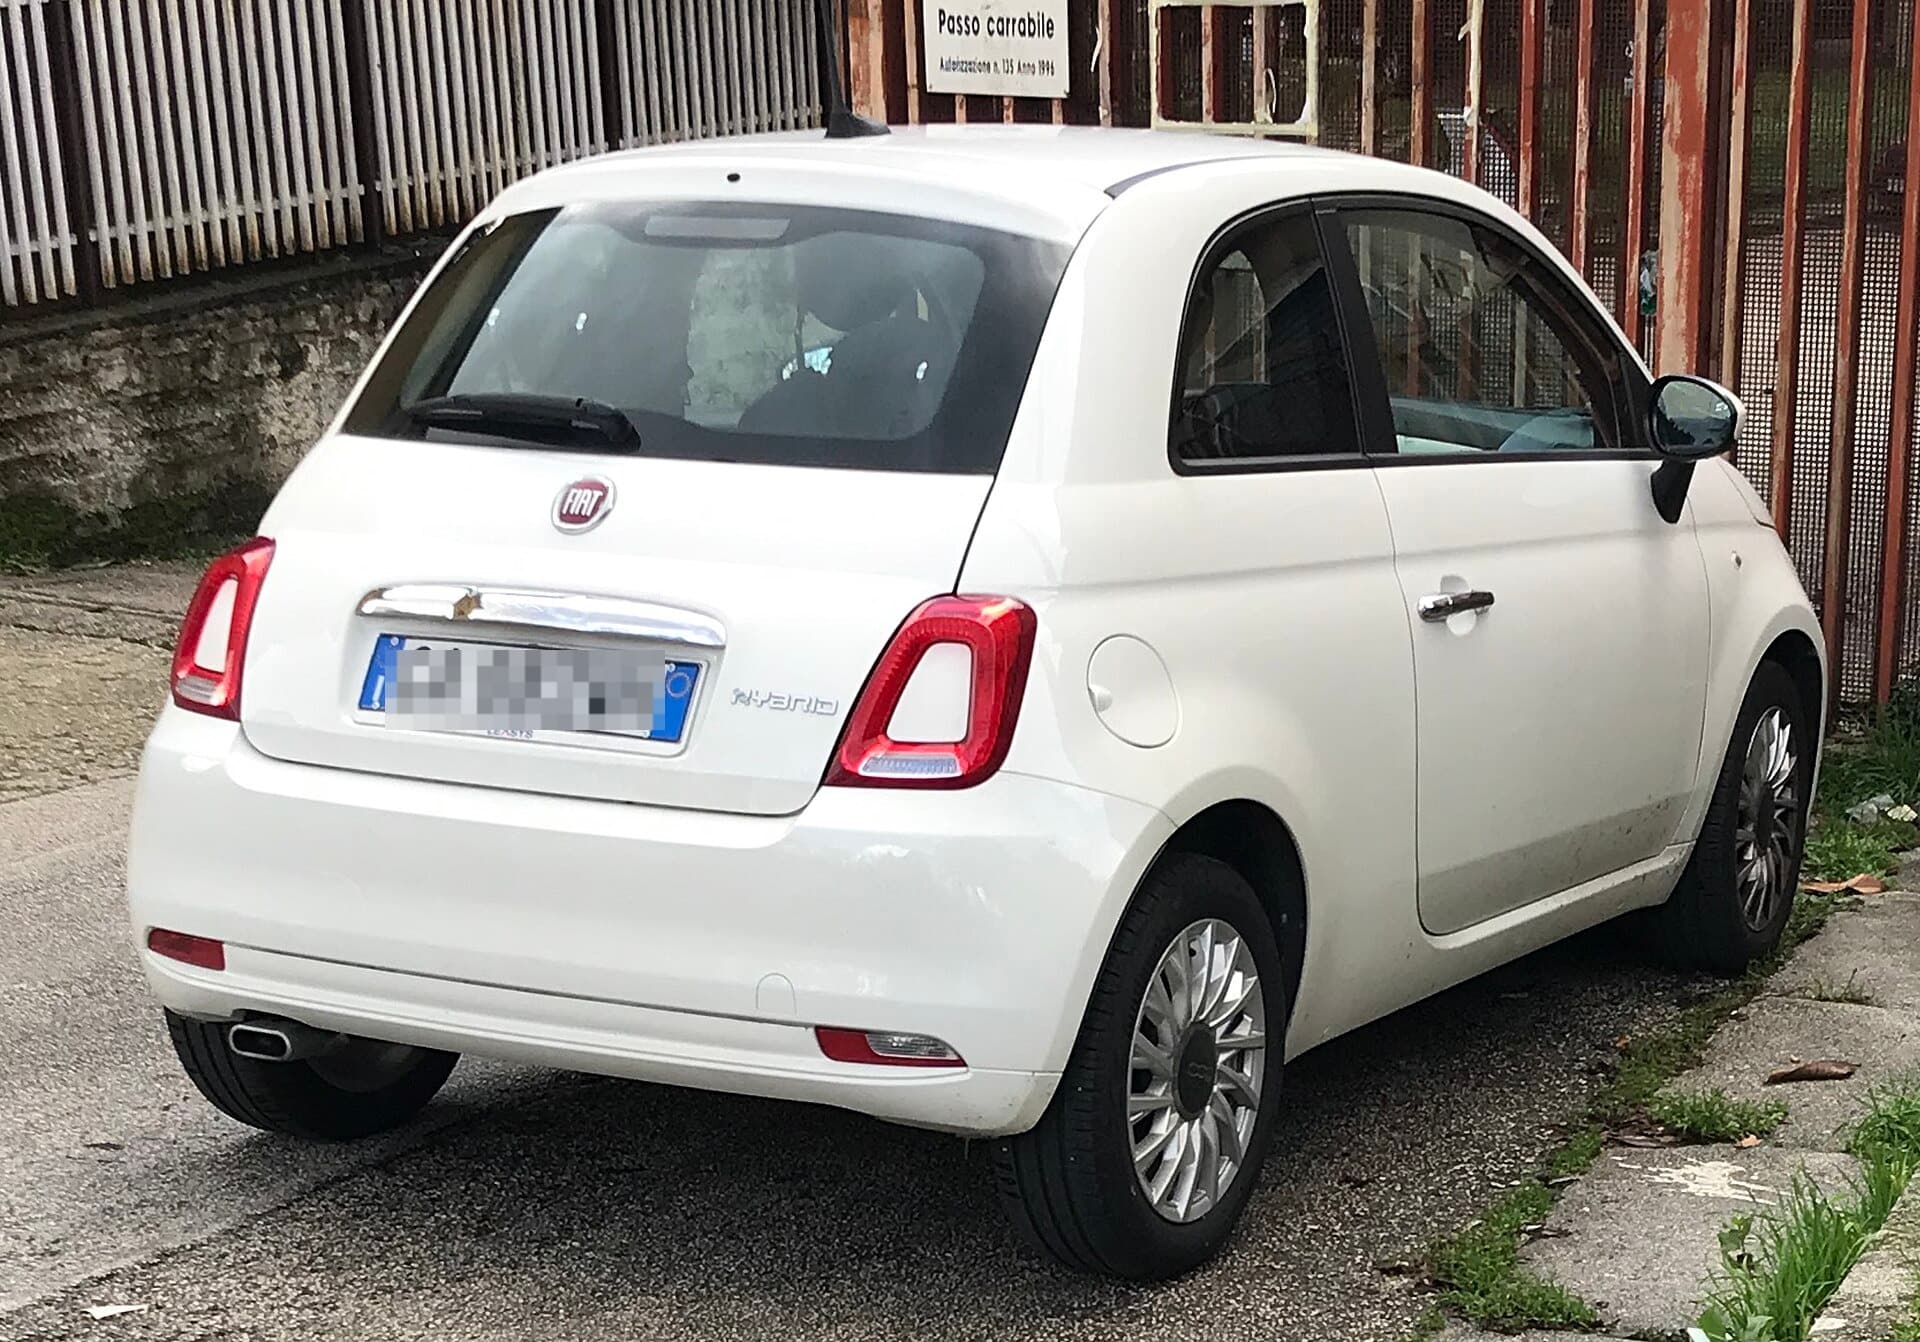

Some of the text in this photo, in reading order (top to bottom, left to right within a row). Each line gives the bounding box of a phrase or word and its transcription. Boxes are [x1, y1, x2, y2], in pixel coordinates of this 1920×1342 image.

[938, 9, 1055, 38] Passo carrabile
[940, 56, 991, 73] Autorizzazione
[1002, 58, 1014, 75] 135
[1017, 59, 1036, 76] Anno
[562, 488, 604, 517] FIAT
[731, 687, 839, 716] HYBRID
